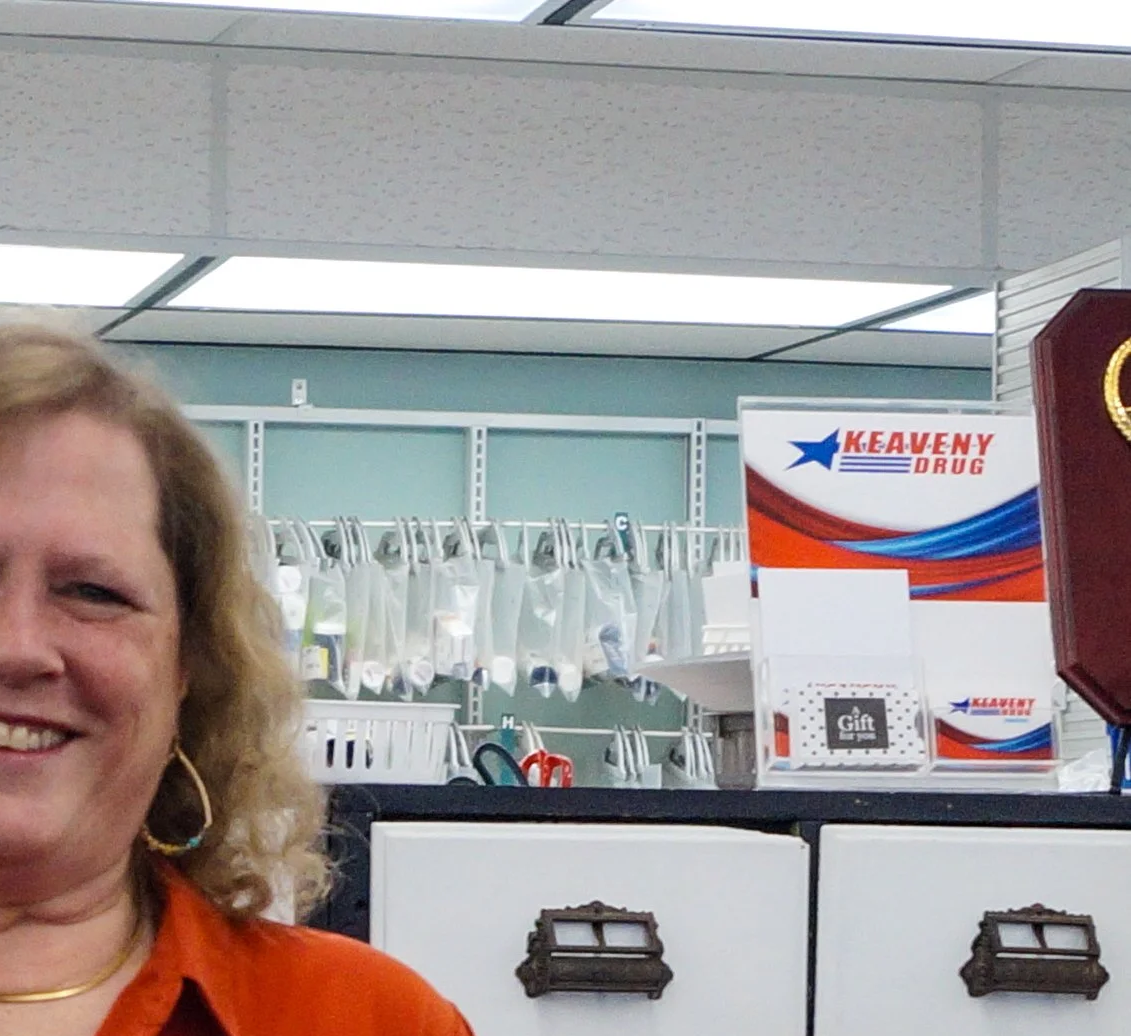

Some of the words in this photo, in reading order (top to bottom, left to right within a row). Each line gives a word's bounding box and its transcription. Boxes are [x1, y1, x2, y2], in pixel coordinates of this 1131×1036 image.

[843, 430, 995, 456] KEAVENY
[914, 457, 984, 475] DRUG
[615, 515, 627, 530] C
[502, 715, 514, 729] H
[837, 713, 875, 732] Gift
